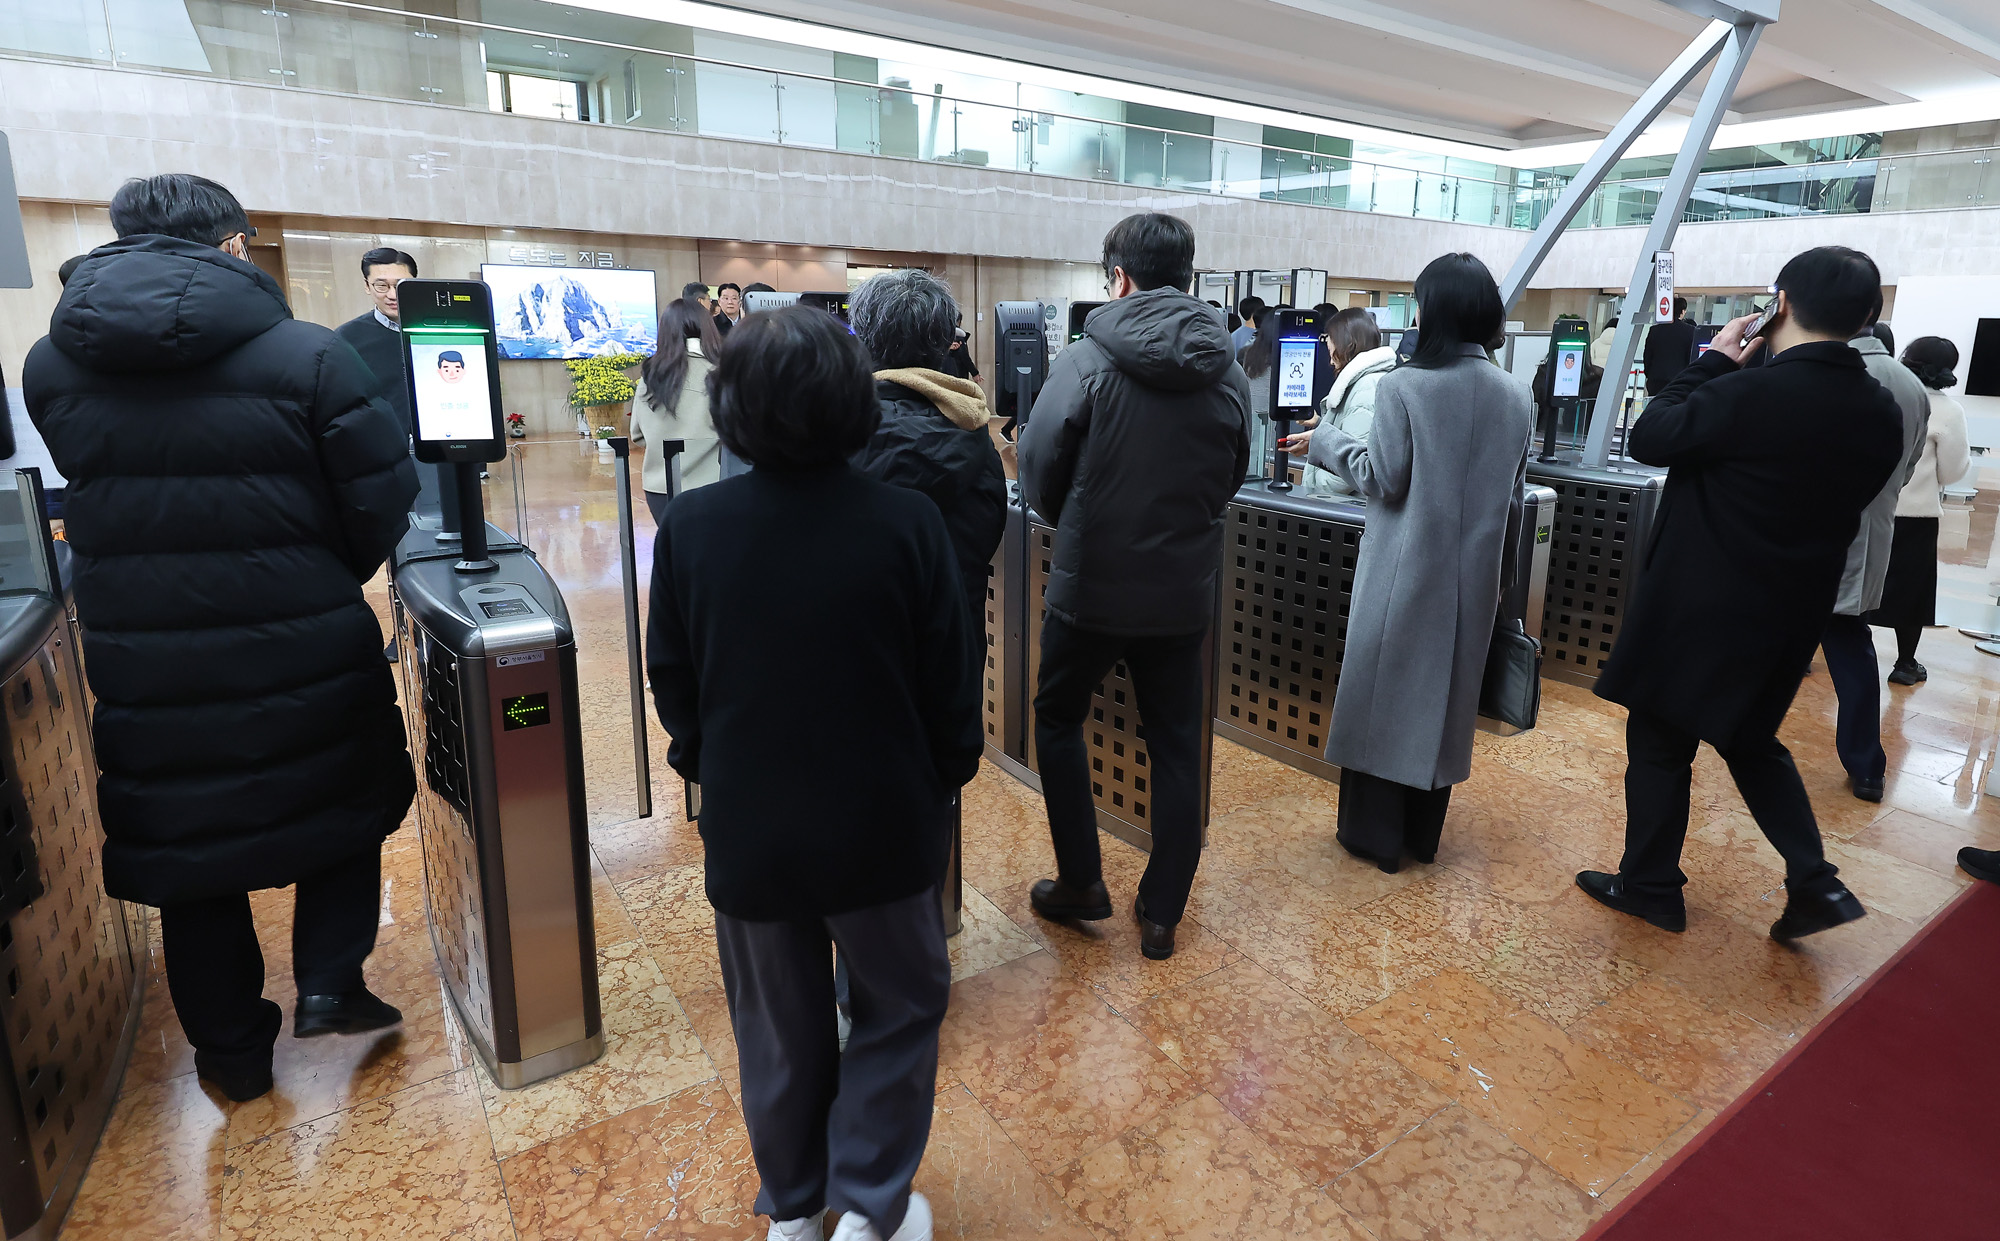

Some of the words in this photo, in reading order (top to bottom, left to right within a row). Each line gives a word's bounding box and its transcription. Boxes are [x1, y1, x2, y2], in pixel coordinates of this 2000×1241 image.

[509, 245, 567, 267] 독도는
[1658, 258, 1673, 275] 출구전용
[1658, 276, 1673, 292] (2레인)
[1046, 333, 1061, 341] 보호!
[511, 653, 542, 662] 정부서울청사
